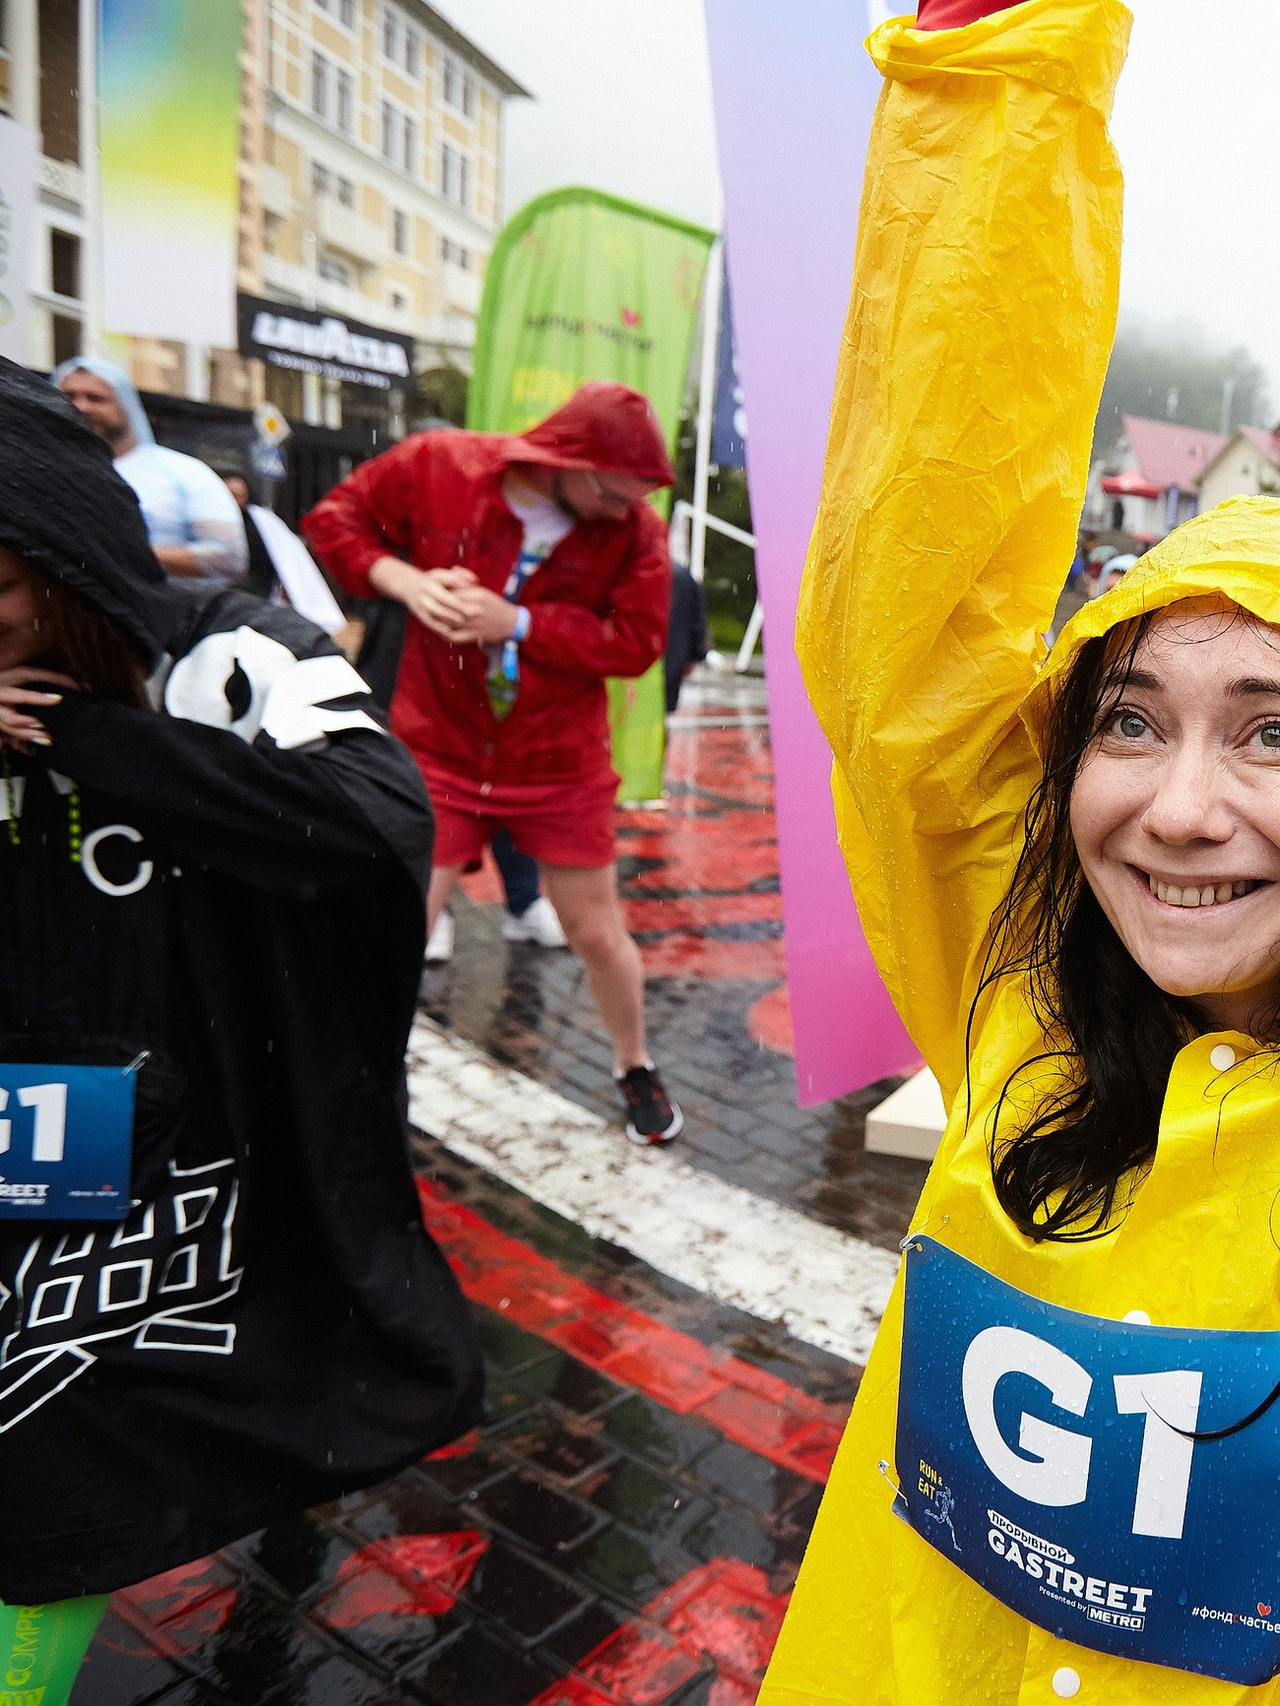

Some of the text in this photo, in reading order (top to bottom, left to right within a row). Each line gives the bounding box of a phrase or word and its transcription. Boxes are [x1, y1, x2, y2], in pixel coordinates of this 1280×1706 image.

[962, 1326, 1203, 1539] G1
[919, 1459, 938, 1484] RUN
[918, 1477, 936, 1500] EAT
[990, 1512, 1068, 1563] ПРОРЫВНОЙ
[987, 1528, 1153, 1613] GASTREET
[1077, 1599, 1088, 1613] by
[1090, 1606, 1142, 1629] METRO
